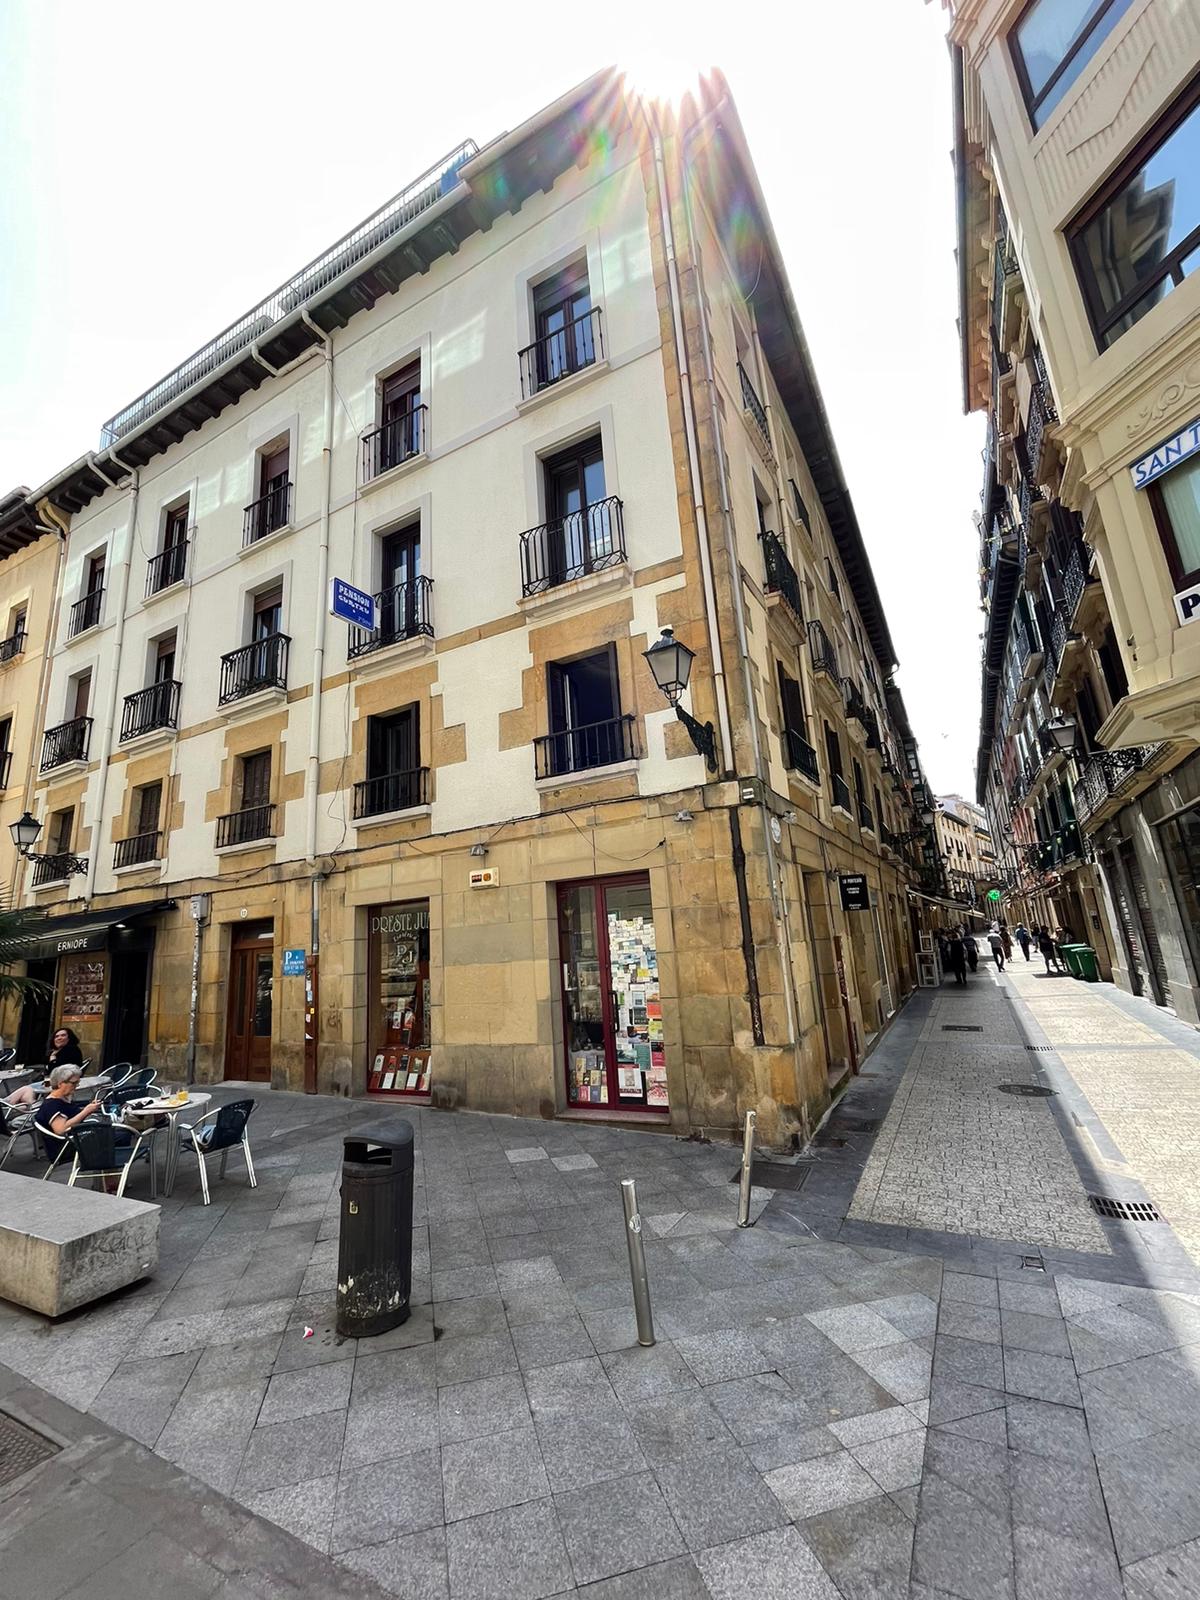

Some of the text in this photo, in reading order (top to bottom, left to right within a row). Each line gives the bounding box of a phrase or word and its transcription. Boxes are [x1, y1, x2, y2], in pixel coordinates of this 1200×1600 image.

[1135, 436, 1182, 484] SAN
[338, 584, 370, 608] PENSION
[371, 913, 412, 934] PRESTE
[57, 937, 89, 952] ERNIOPE
